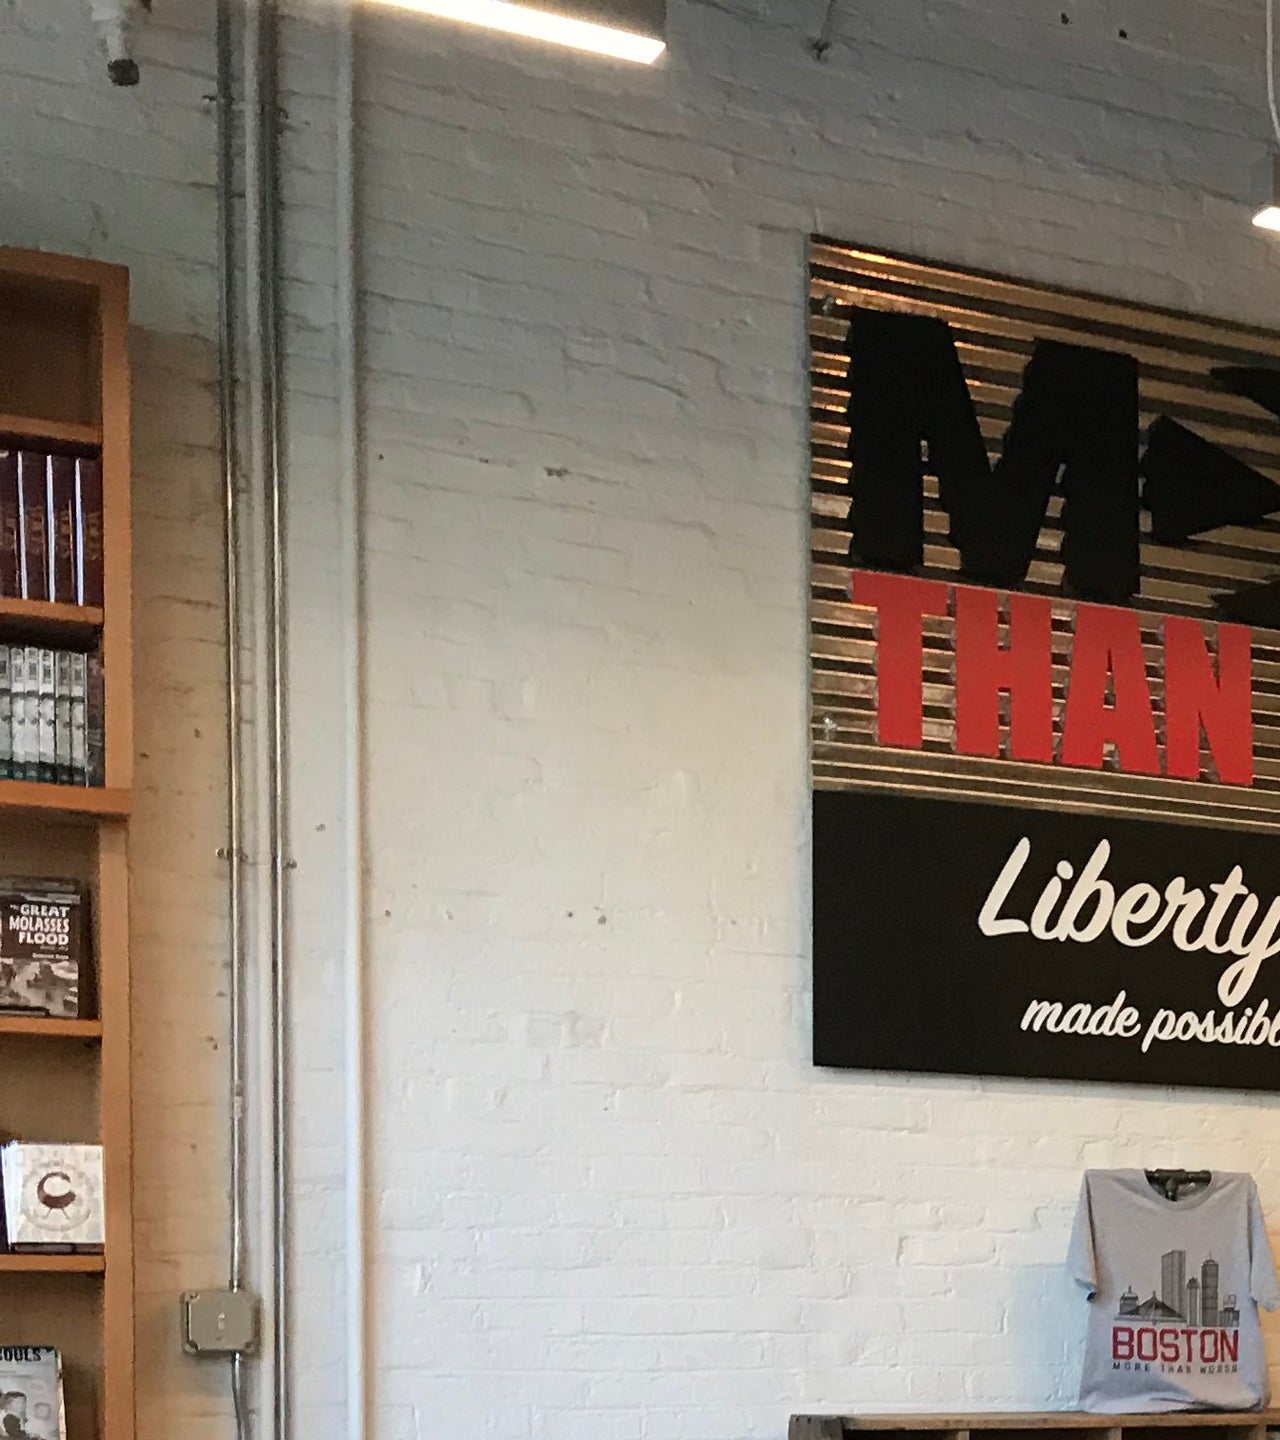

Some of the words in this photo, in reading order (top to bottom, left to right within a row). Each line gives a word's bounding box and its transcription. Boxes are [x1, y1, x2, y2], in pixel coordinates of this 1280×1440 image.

[850, 569, 1254, 787] THAN
[8, 915, 70, 934] MOLASSES
[20, 903, 71, 918] GREAT
[18, 930, 70, 946] FLOOD
[1020, 990, 1142, 1037] made
[1112, 1325, 1239, 1363] BOSTON
